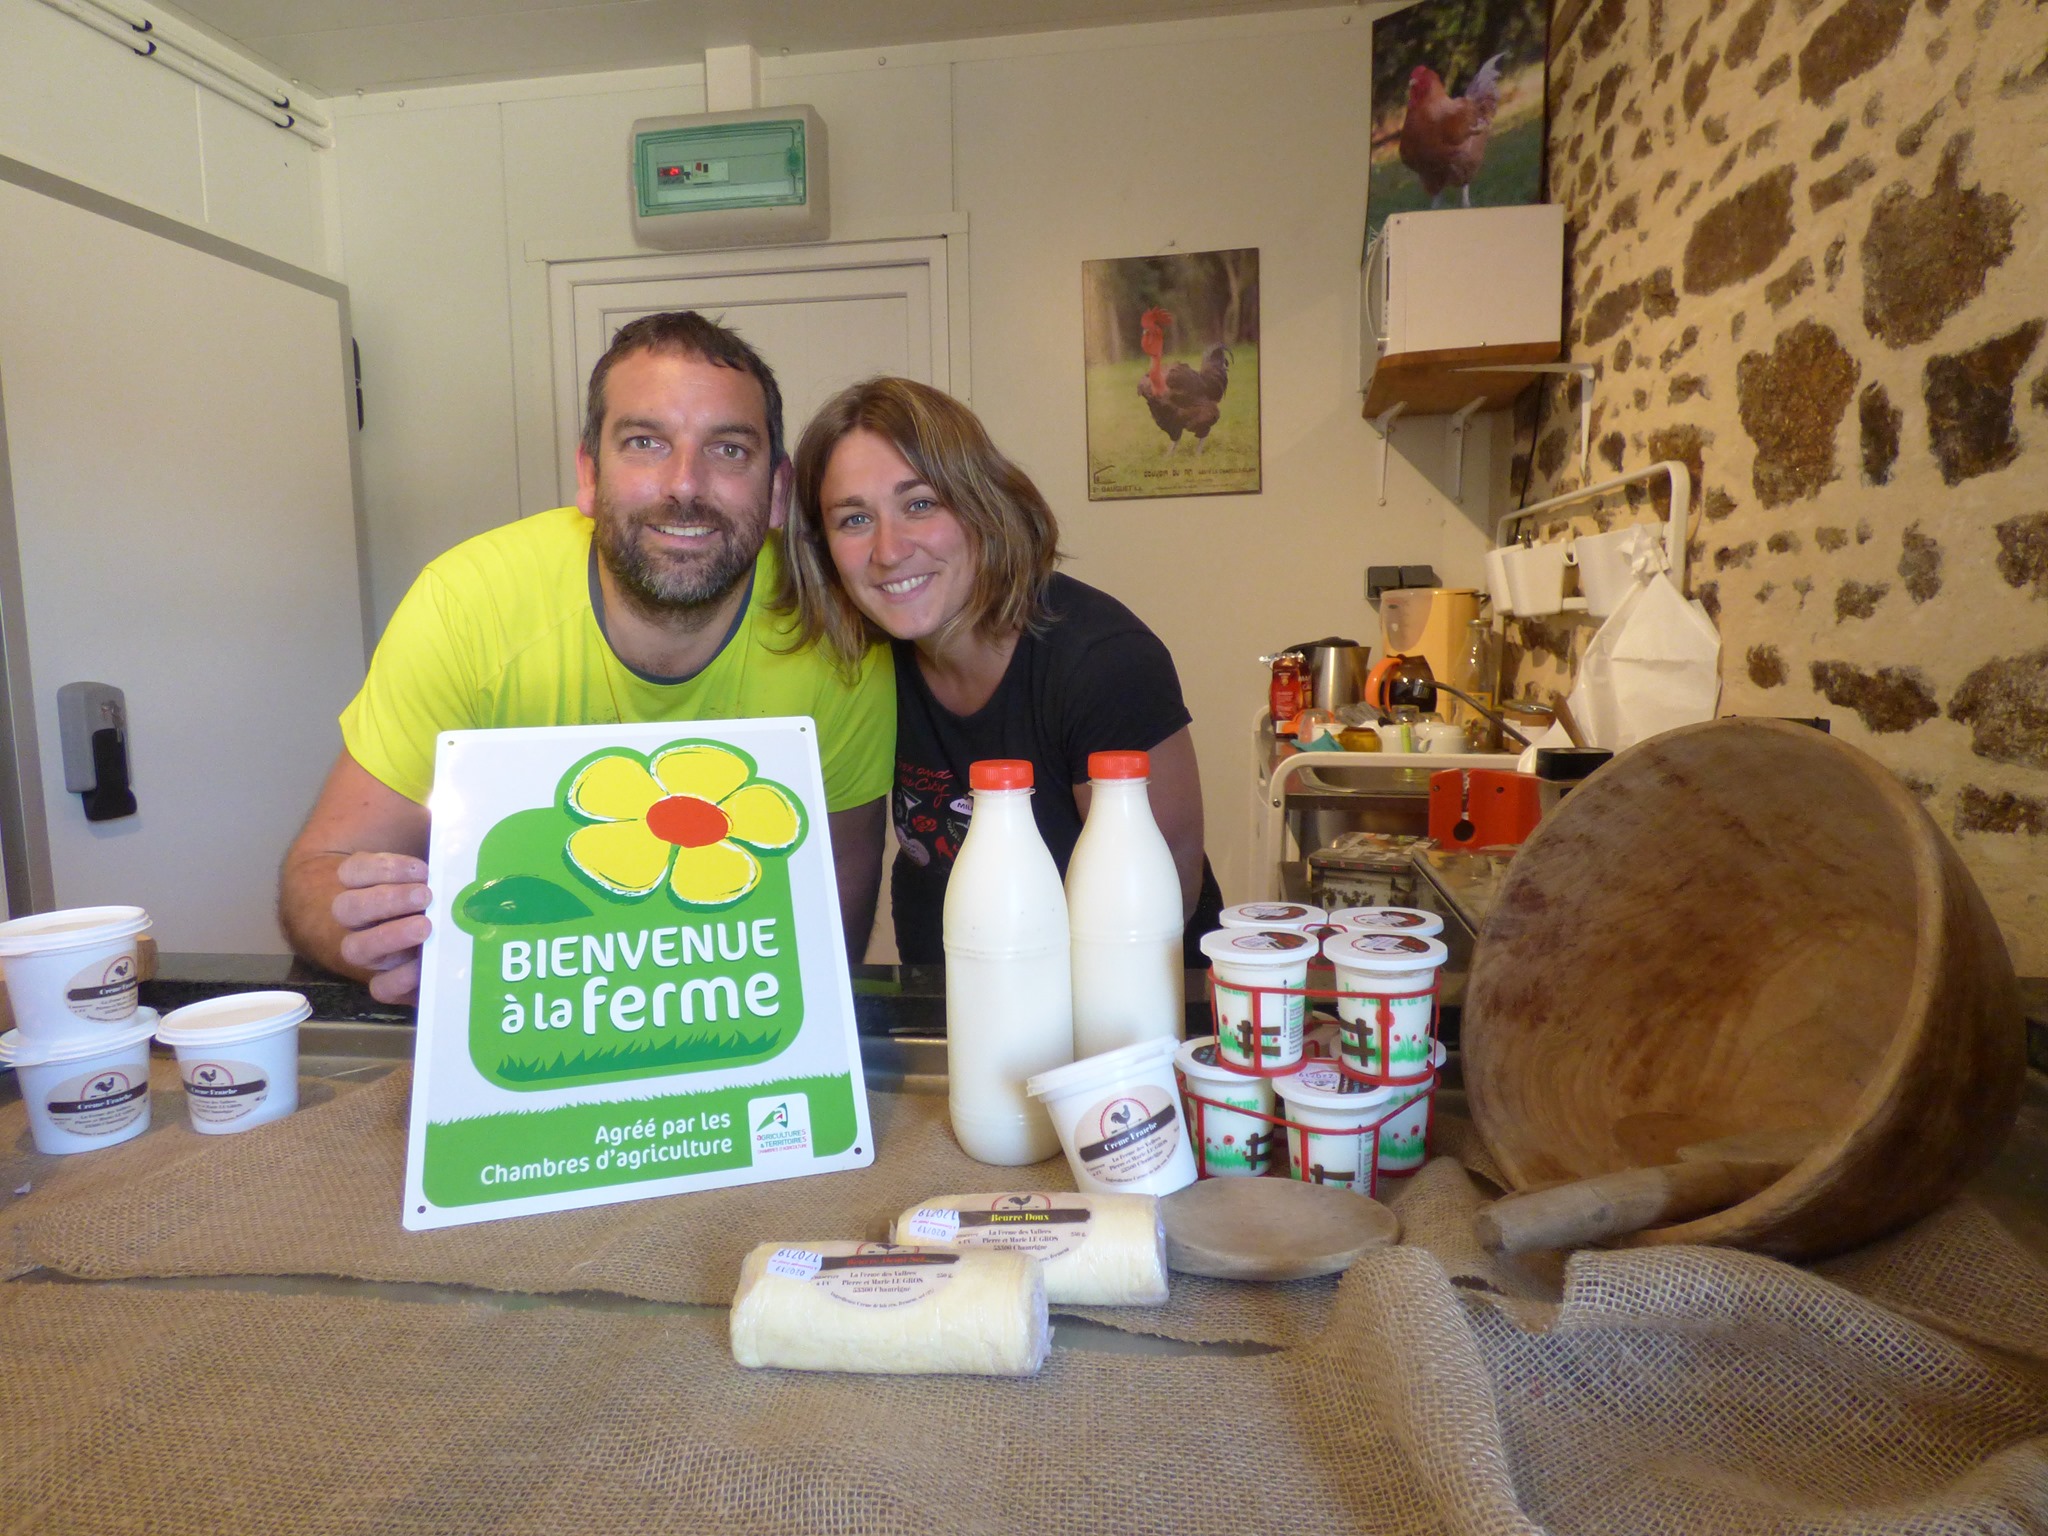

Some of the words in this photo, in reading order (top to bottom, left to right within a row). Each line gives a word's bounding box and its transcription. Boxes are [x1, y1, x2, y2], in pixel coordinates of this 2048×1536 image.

[916, 767, 954, 780] and
[501, 918, 780, 983] BIENVENUE
[501, 993, 525, 1033] à
[534, 992, 572, 1030] la
[582, 972, 780, 1035] ferme
[594, 1118, 657, 1147] Agréé
[662, 1116, 695, 1140] par
[700, 1112, 731, 1131] les
[480, 1154, 591, 1186] Chambres
[595, 1137, 733, 1170] d'agriculture
[991, 1213, 1023, 1222] Beurre
[1025, 1213, 1050, 1221] Doux
